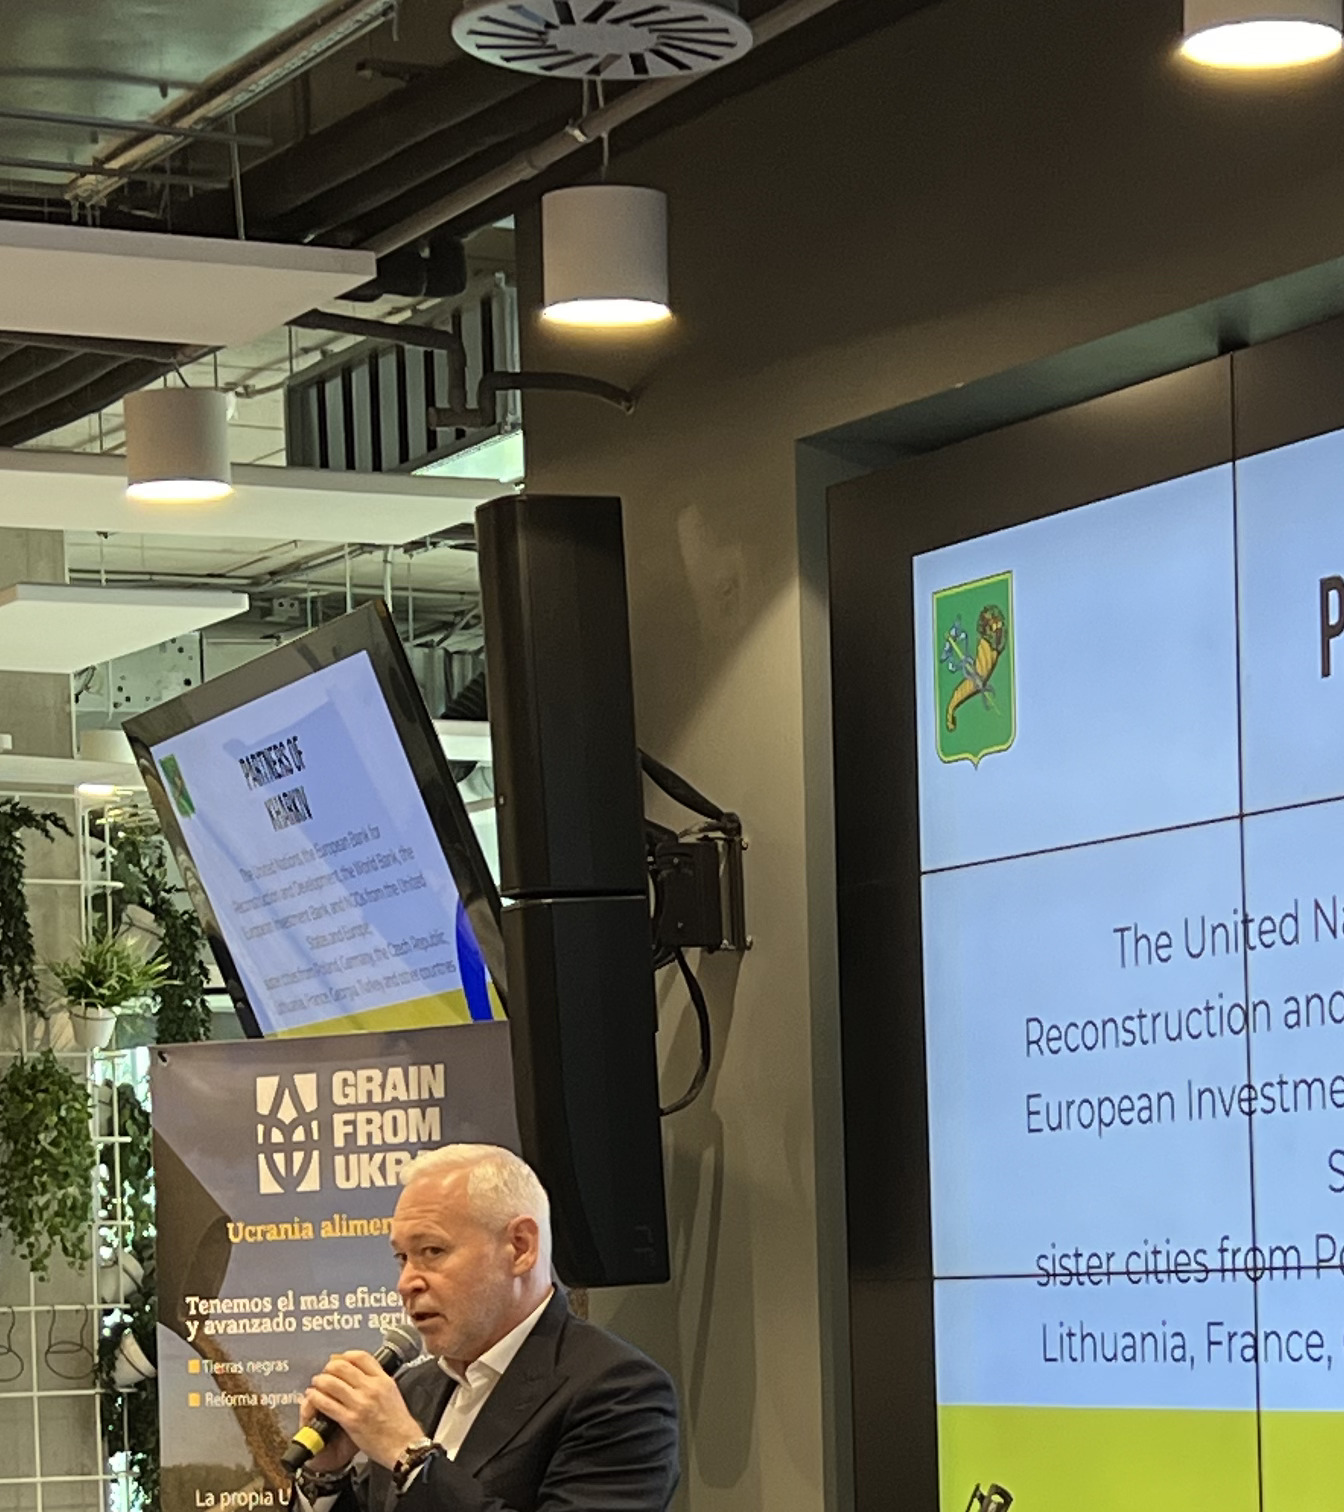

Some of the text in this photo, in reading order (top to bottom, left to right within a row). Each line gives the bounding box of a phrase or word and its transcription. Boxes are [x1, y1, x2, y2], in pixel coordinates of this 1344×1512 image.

[1113, 926, 1173, 969] The
[1184, 899, 1301, 960] United
[1025, 992, 1271, 1058] Reconstruction
[331, 1063, 446, 1106] GRAIN
[332, 1106, 442, 1148] FROM
[1026, 1089, 1175, 1139] European
[333, 1150, 411, 1190] UKR
[226, 1213, 394, 1244] Ucrania alimen
[1035, 1242, 1116, 1288] sister
[1125, 1237, 1209, 1286] cities
[1217, 1235, 1302, 1283] from
[184, 1295, 273, 1316] Tenemos
[277, 1289, 295, 1312] el
[299, 1289, 341, 1311] más
[184, 1319, 200, 1343] y
[203, 1311, 297, 1335] avanzado
[302, 1311, 363, 1332] sector
[1041, 1319, 1196, 1371] Lithuania,
[1205, 1319, 1334, 1371] France,
[201, 1359, 290, 1376] Tierras negras
[204, 1390, 258, 1408] Reforma
[195, 1488, 215, 1507] La
[219, 1488, 274, 1511] propia
